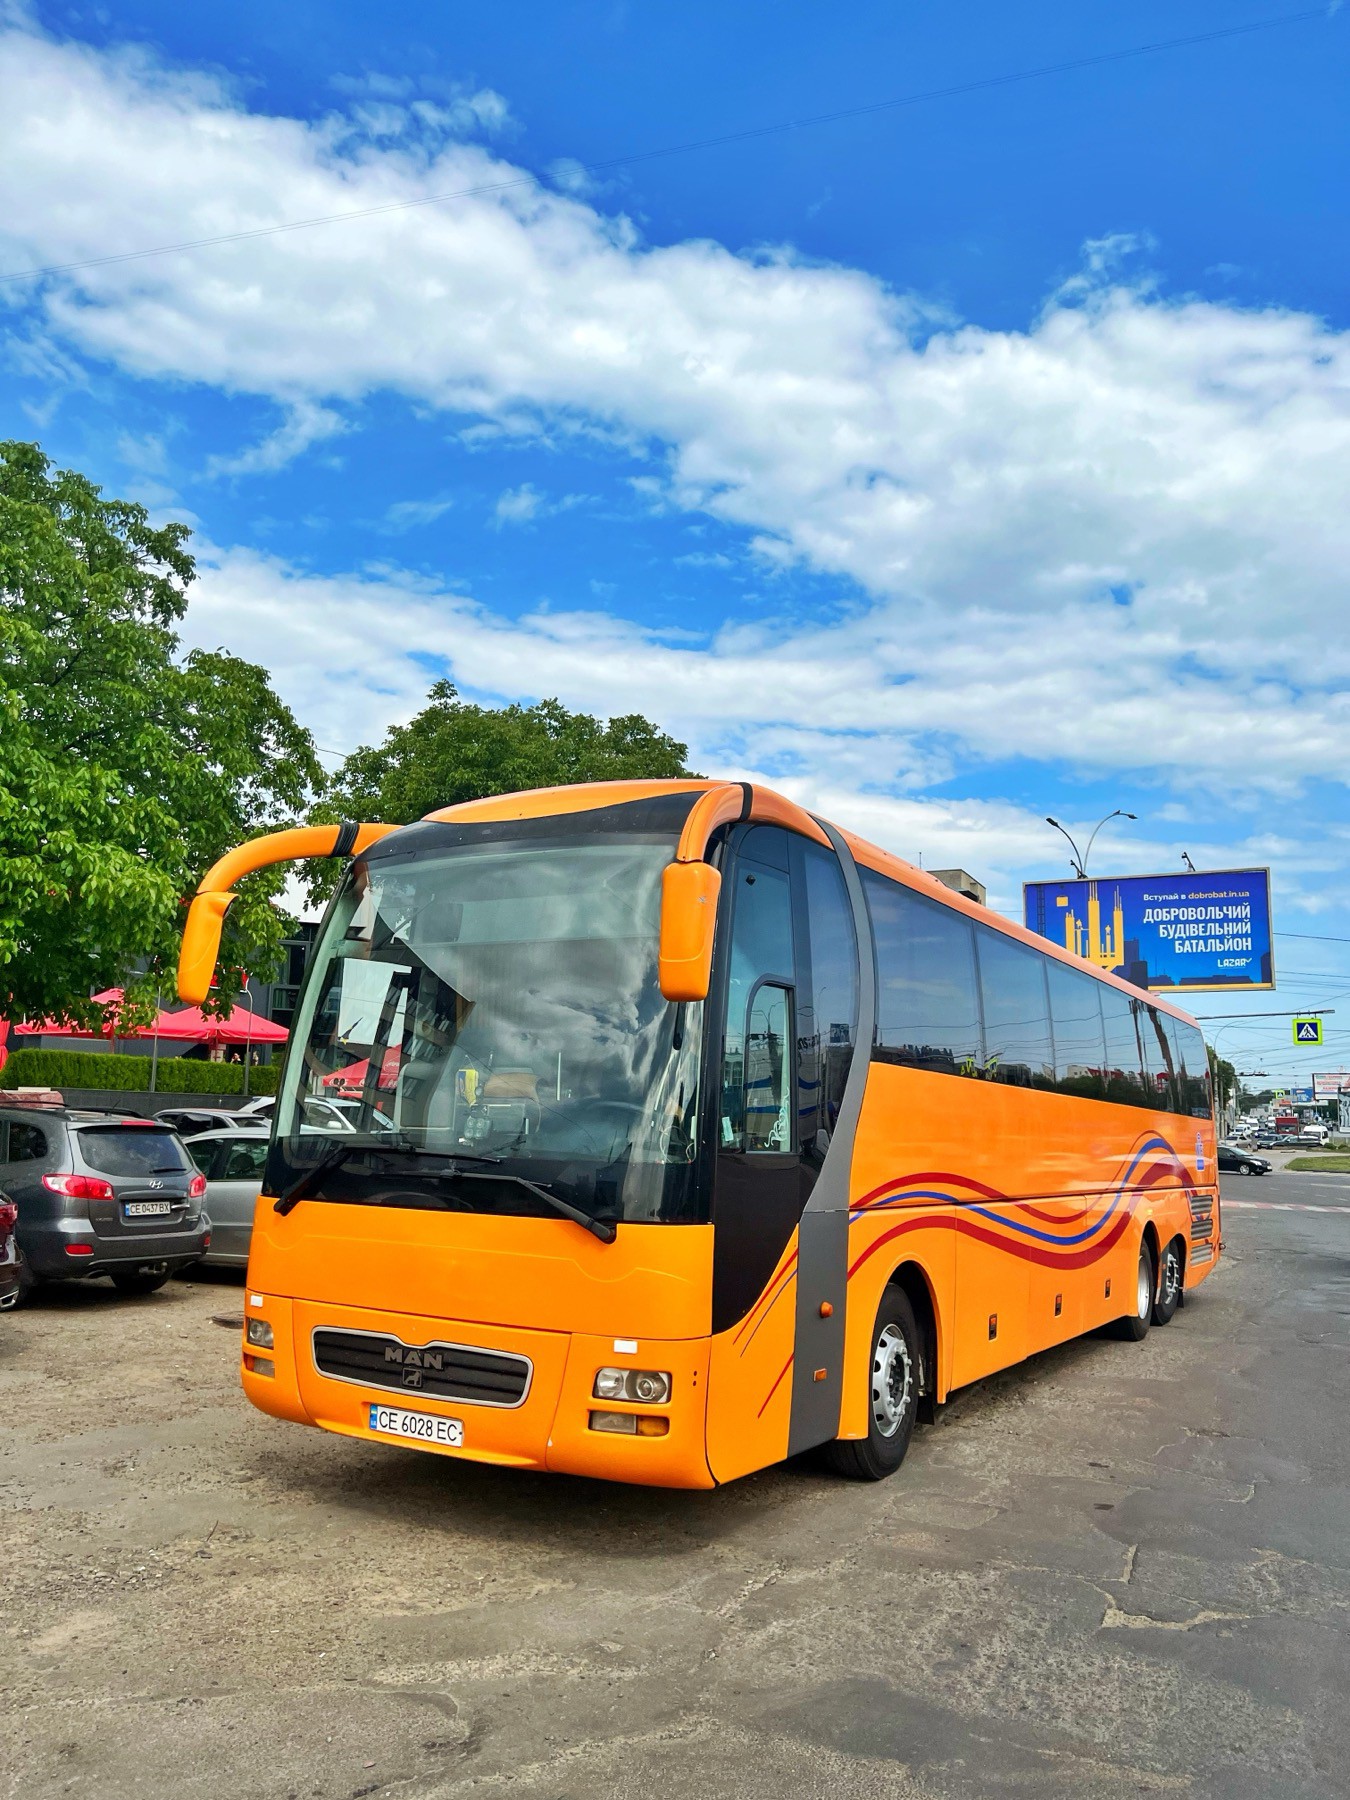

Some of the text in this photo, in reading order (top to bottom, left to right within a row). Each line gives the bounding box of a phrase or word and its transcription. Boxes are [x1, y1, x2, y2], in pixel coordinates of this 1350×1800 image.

[1143, 893, 1179, 902] Вступай
[1188, 890, 1250, 899] dobrobat.in.ua
[1143, 902, 1251, 924] ДОБРОВОЛЬЧИЙ
[1159, 919, 1251, 939] БУДІВЕЛЬНИЙ
[1175, 935, 1252, 953] БАТАЛЬЙОН
[1217, 958, 1251, 968] LAZAR
[129, 1202, 170, 1214] CE 0437 BX
[384, 1346, 443, 1370] MAN
[379, 1411, 458, 1441] CE 6028 EC
